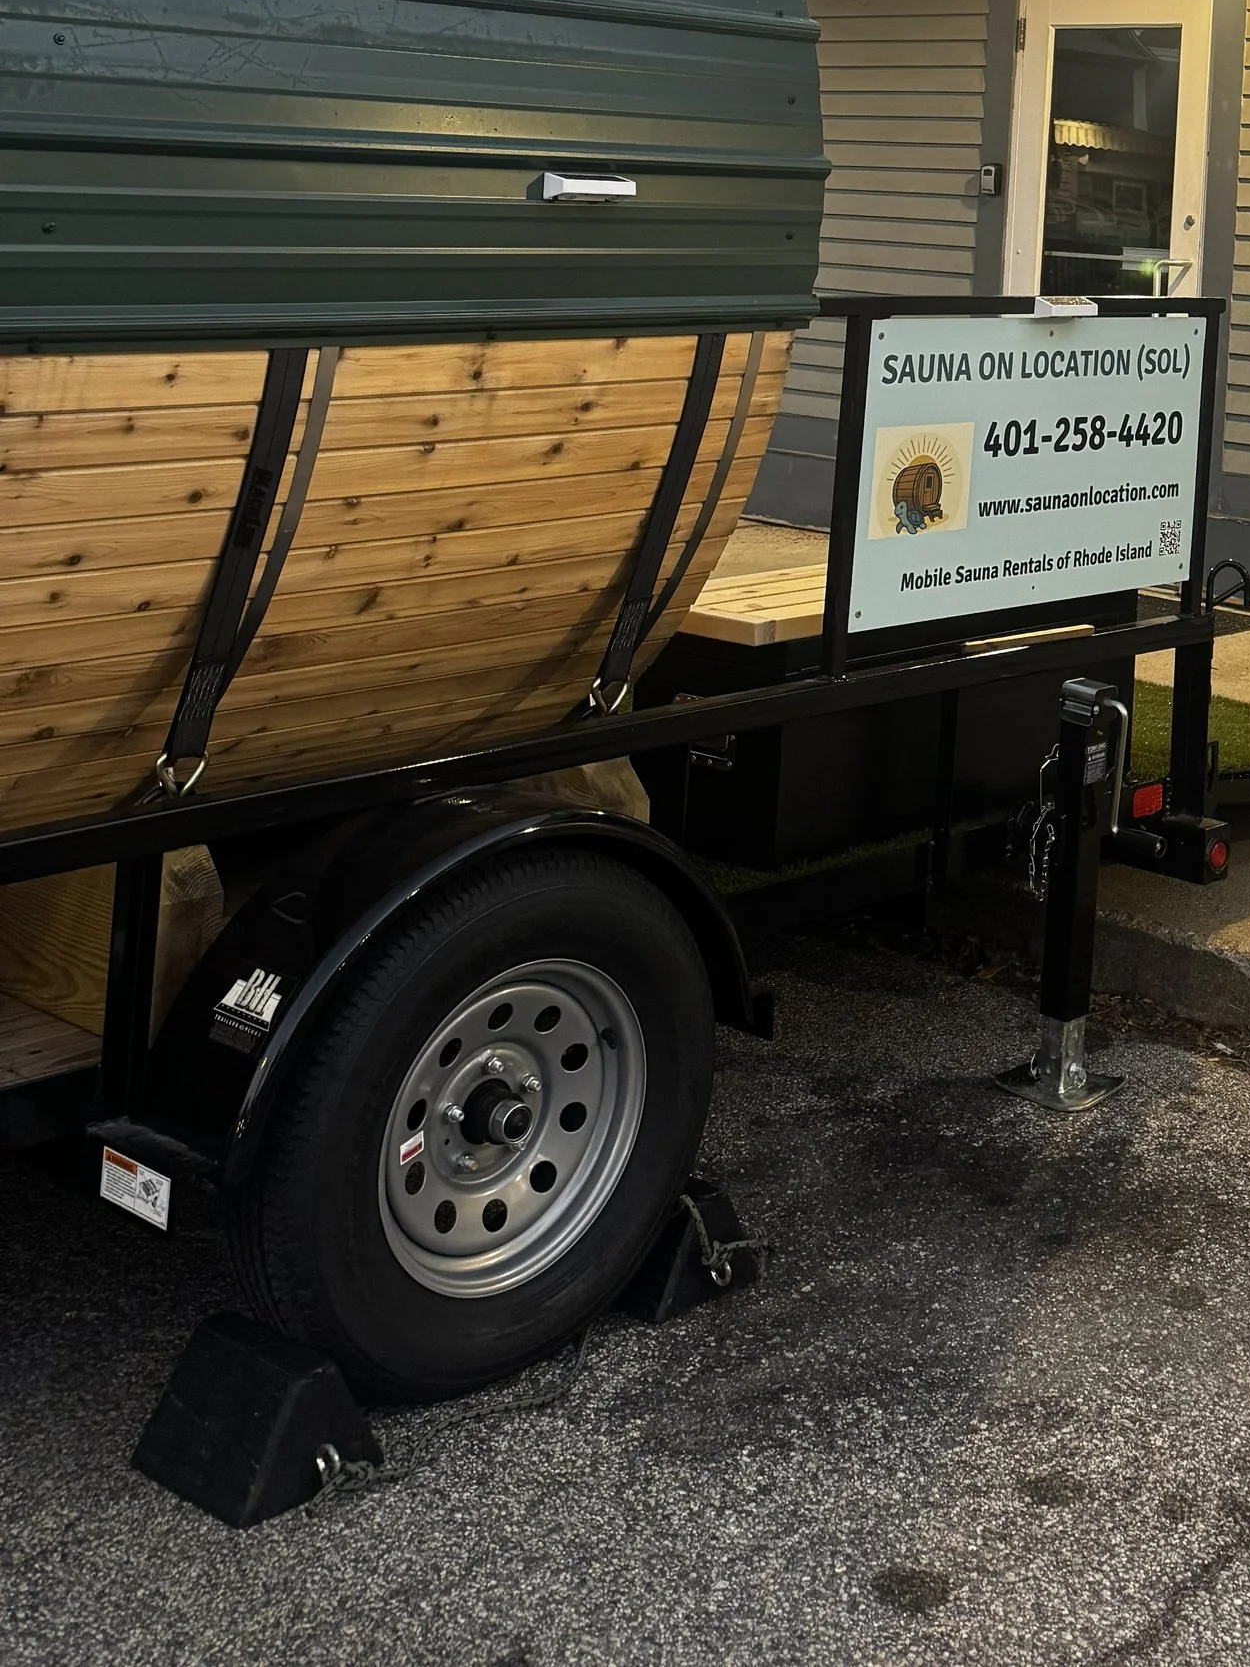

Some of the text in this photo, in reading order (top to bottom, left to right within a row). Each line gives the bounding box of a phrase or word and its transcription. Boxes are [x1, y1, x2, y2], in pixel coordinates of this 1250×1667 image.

[881, 343, 1191, 384] SAUNA ON LOCATION (SOL)
[984, 410, 1183, 457] 401-258-4420
[978, 483, 1179, 517] www.saunaonlocation.com
[900, 541, 1152, 592] Mobile Sauna Rentals of Rhode Island
